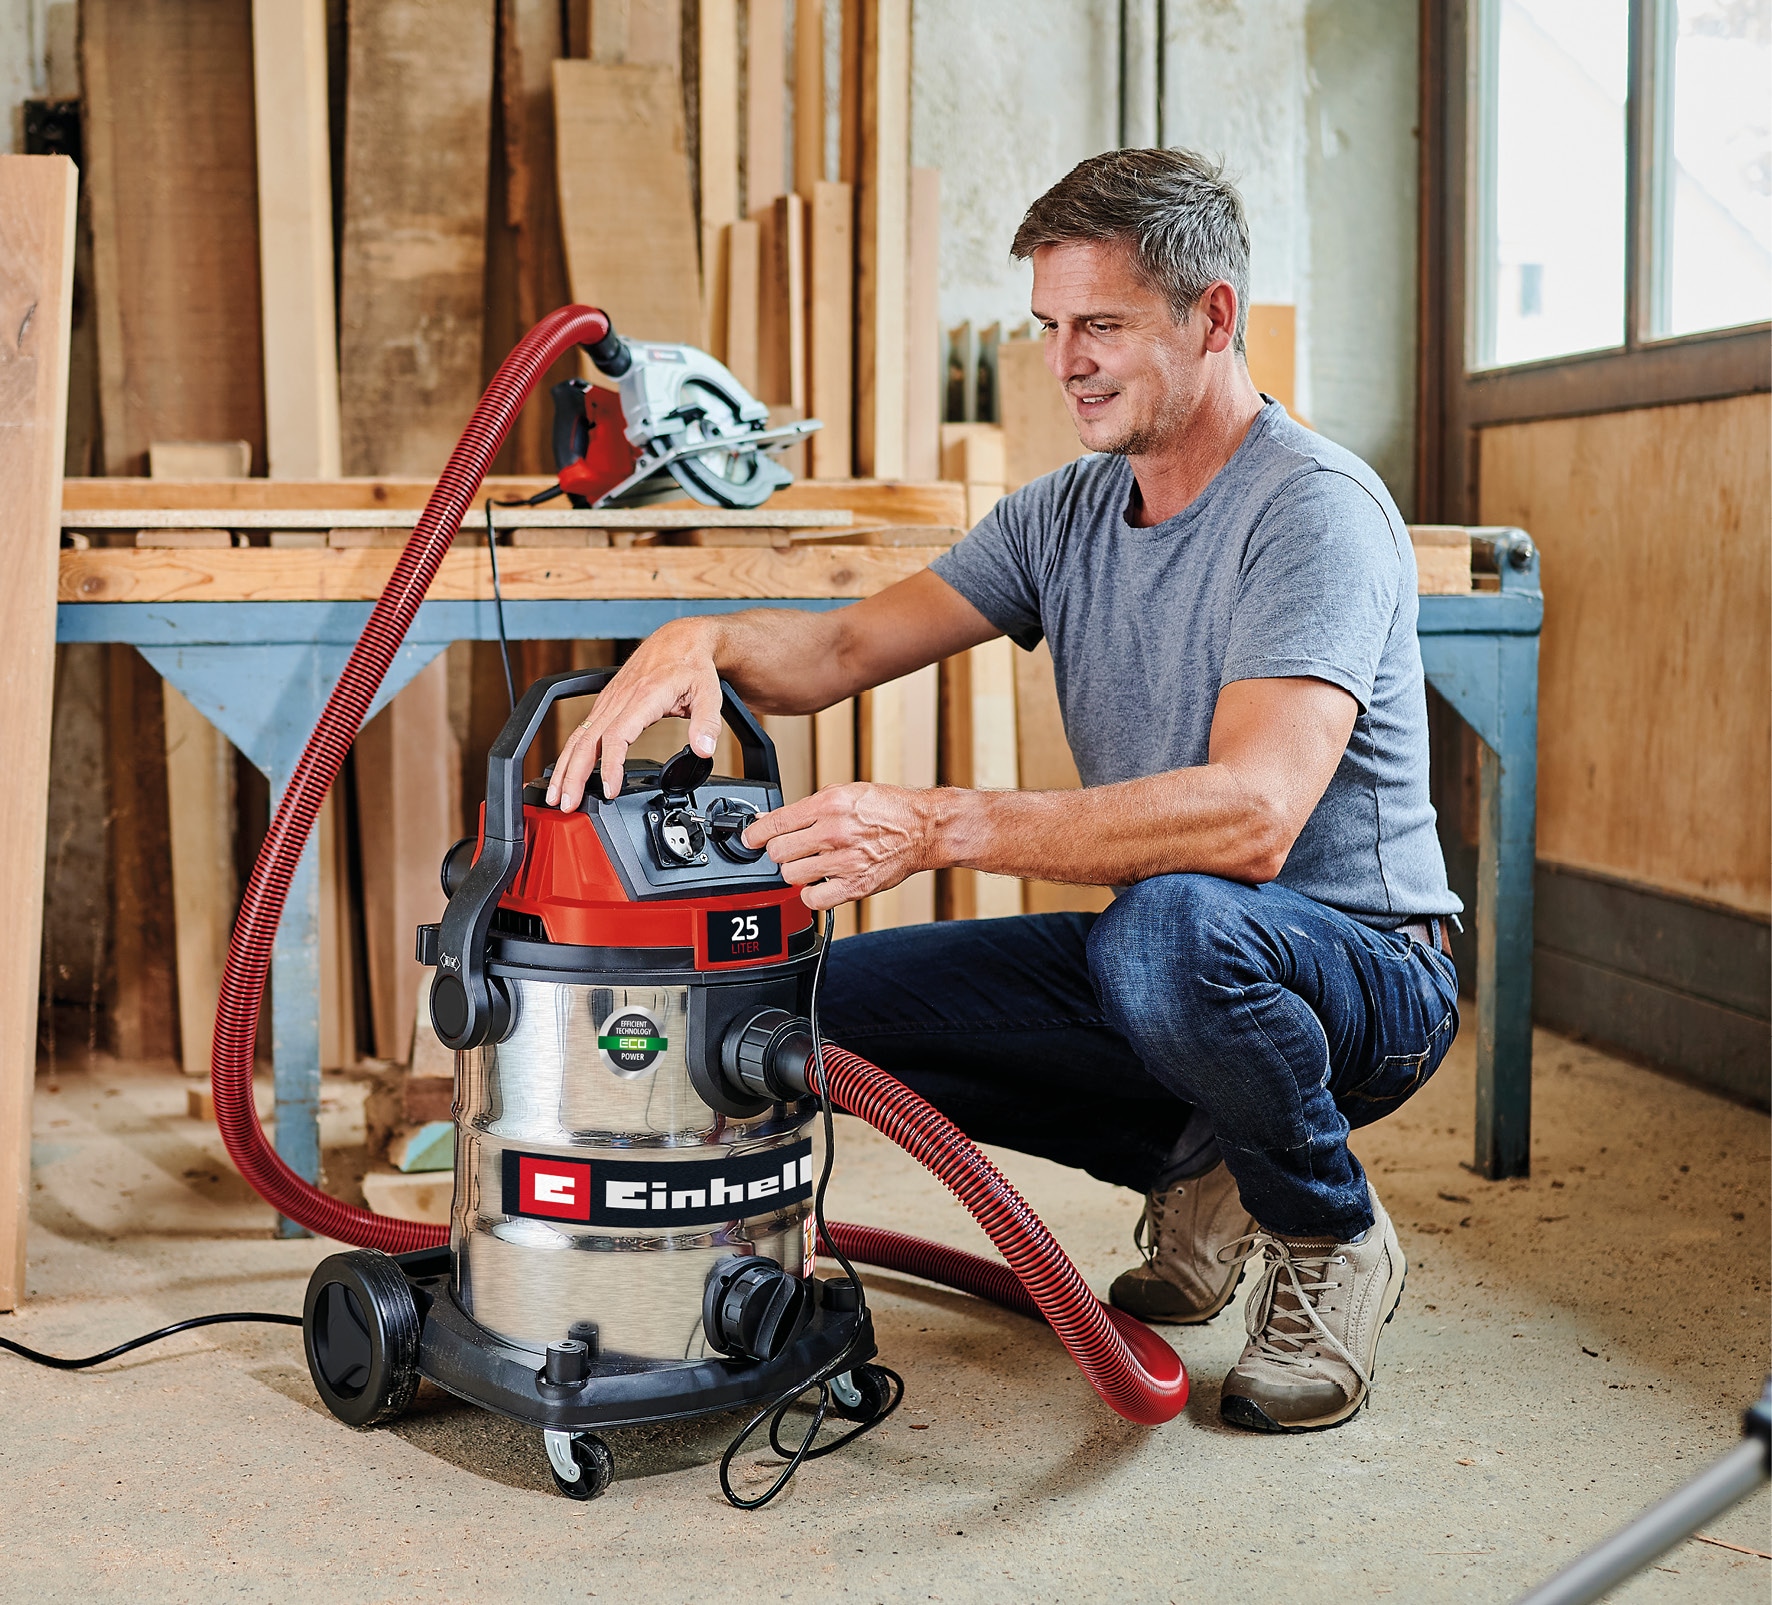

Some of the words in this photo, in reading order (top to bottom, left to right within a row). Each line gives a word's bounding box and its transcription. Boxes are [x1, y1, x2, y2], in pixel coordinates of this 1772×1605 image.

[731, 915, 759, 941] 25
[731, 941, 760, 955] LITER
[620, 1020, 647, 1028] EFFICIENT
[619, 1038, 647, 1049] ECO
[621, 1052, 645, 1061] POWER
[605, 1154, 812, 1210] Einhell
